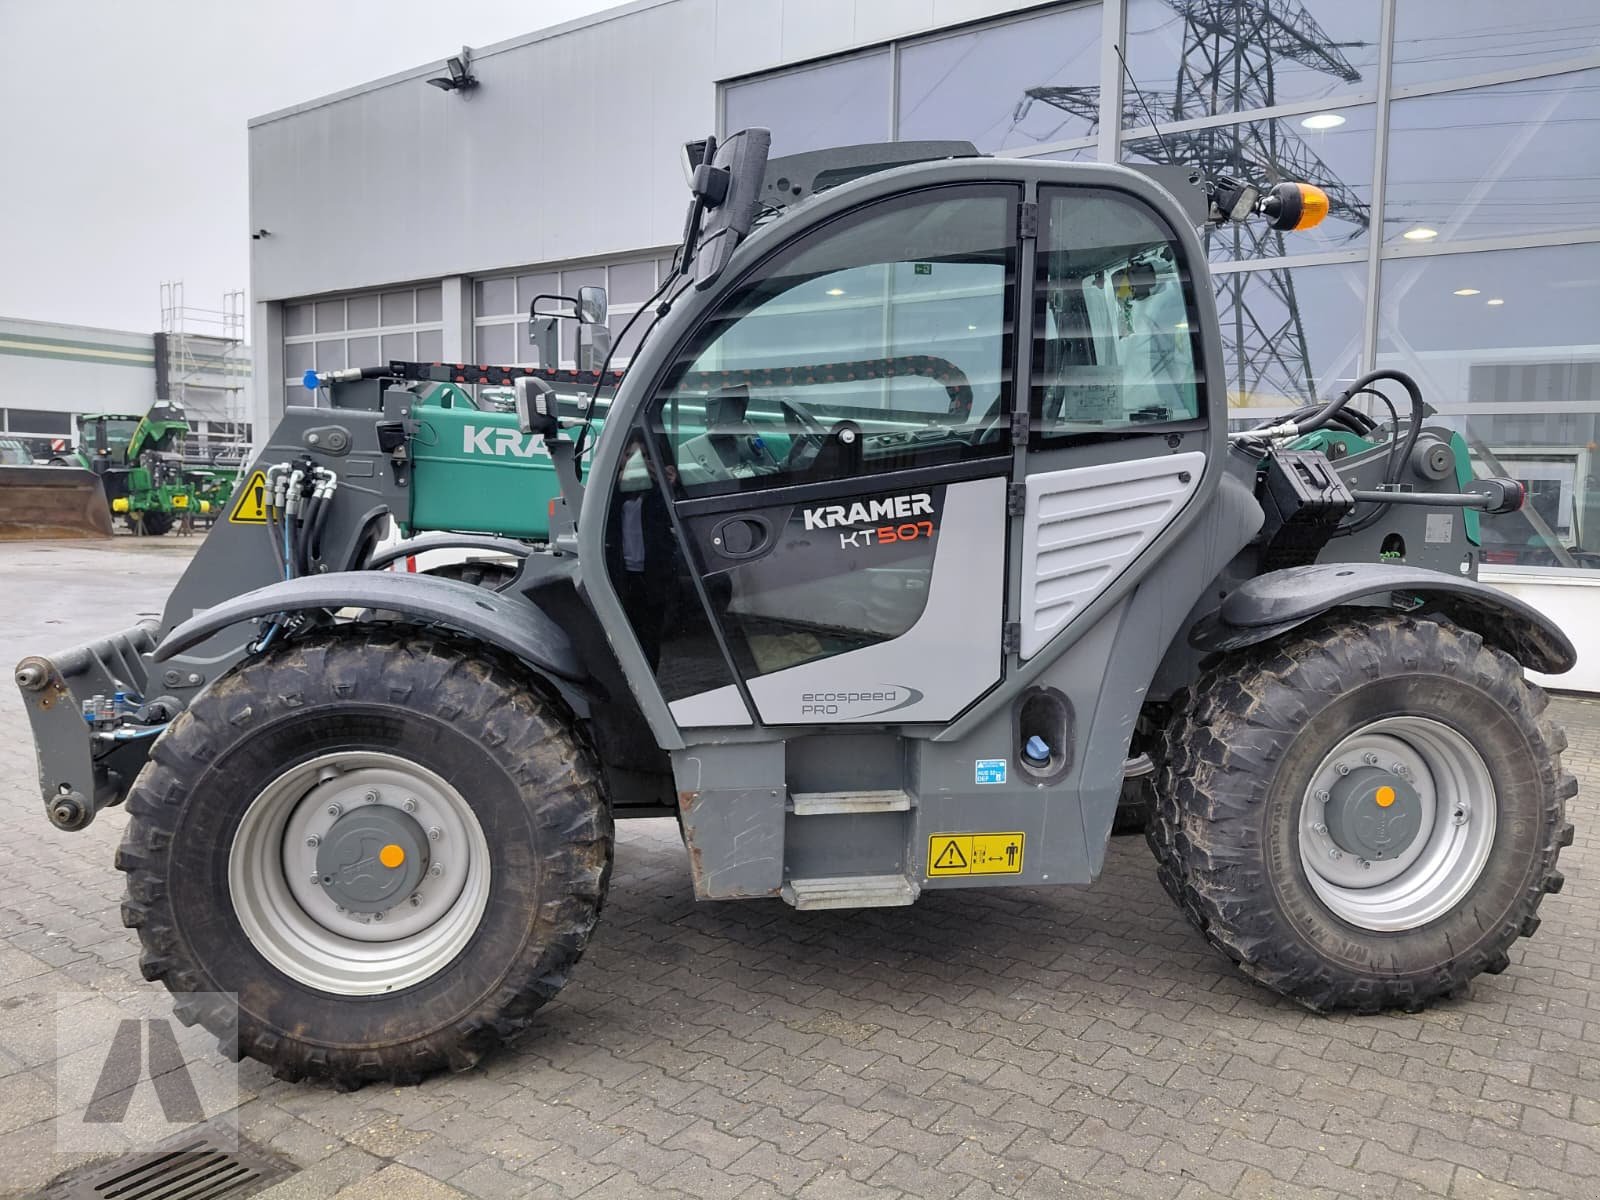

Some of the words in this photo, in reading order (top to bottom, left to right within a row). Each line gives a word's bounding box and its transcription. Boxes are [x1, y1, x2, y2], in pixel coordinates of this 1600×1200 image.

[803, 493, 935, 530] KRAMER
[840, 521, 934, 549] KT507
[802, 691, 896, 704] ecospeed
[802, 705, 838, 715] PRO
